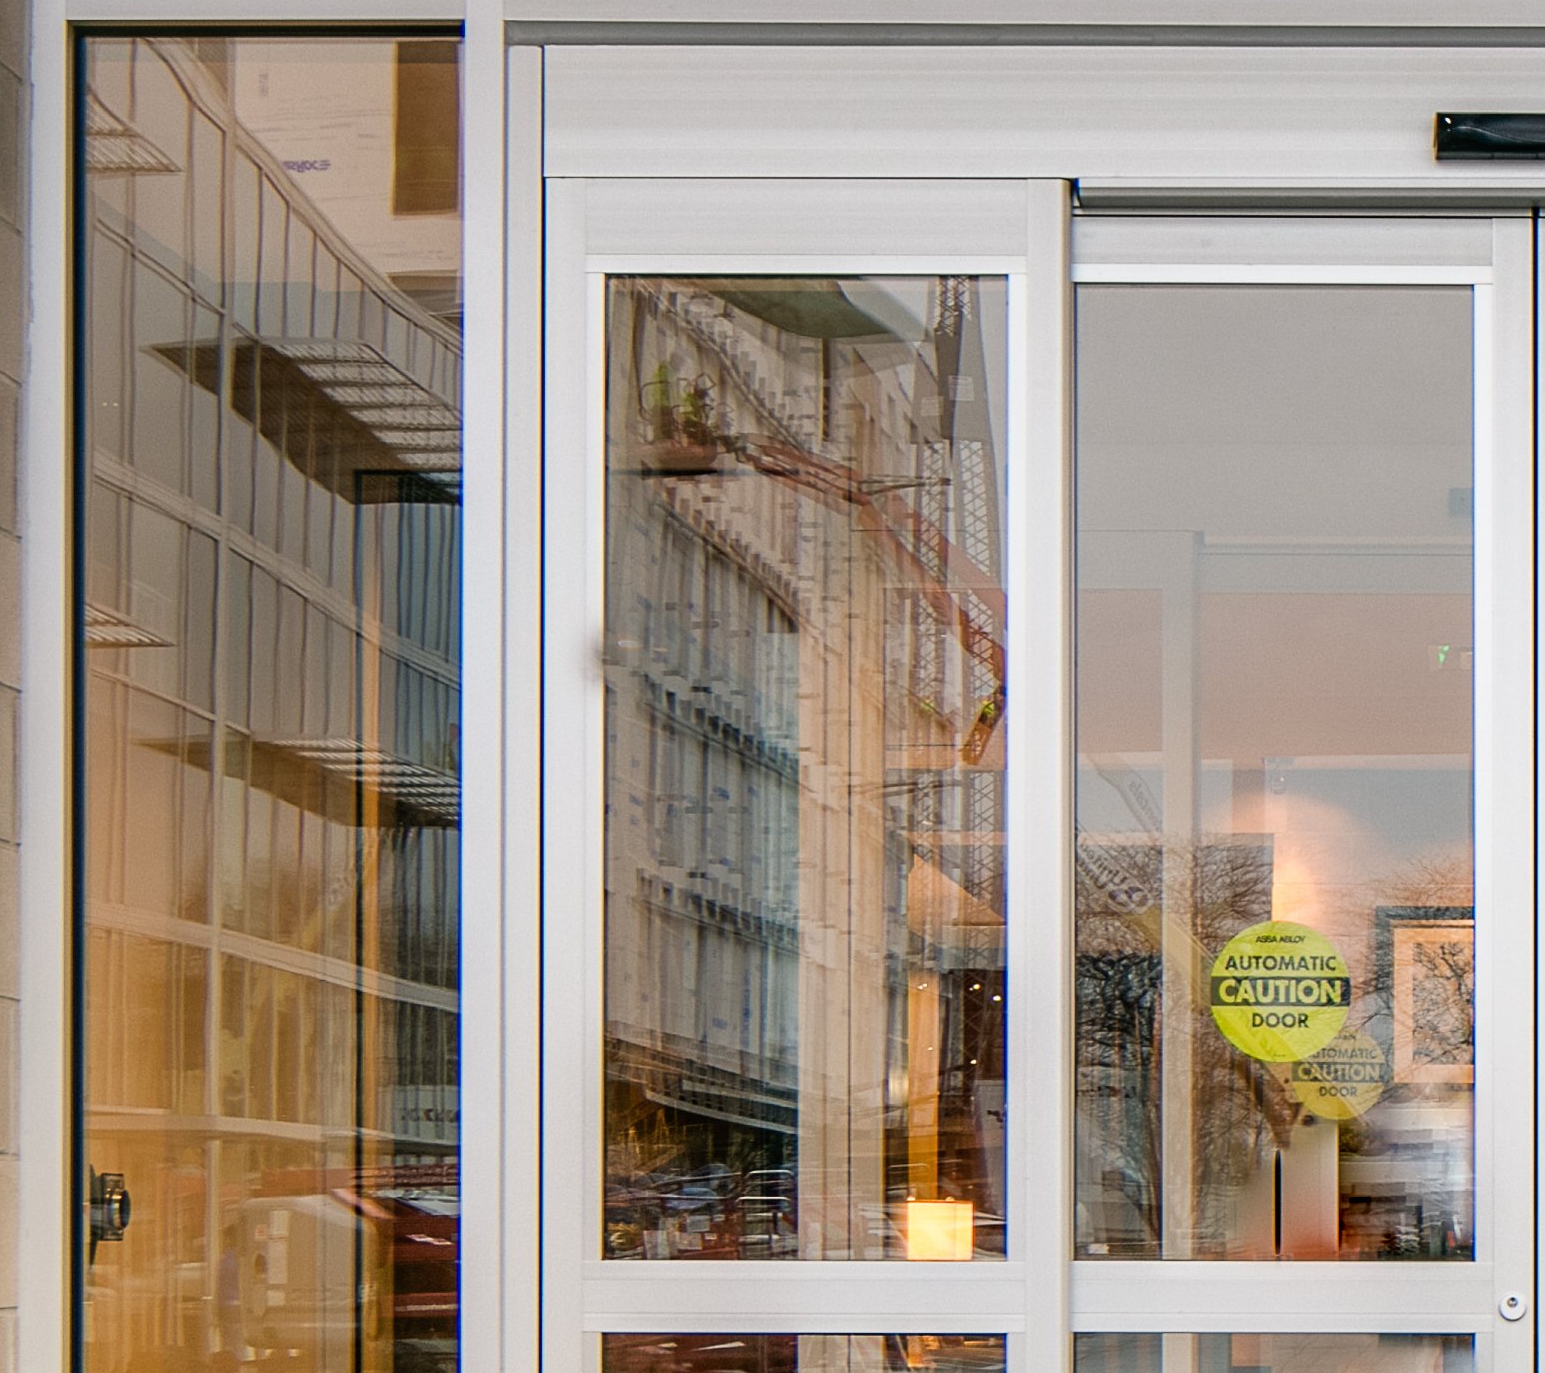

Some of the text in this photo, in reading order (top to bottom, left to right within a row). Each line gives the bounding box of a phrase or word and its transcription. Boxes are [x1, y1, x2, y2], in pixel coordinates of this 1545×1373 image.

[1255, 935, 1306, 944] ASSA ABLOY
[1225, 955, 1337, 971] AUTOMATIC
[1219, 979, 1342, 1004] CAUTION
[1252, 1013, 1309, 1028] DOOR
[1308, 1047, 1377, 1060] UTOMATIC
[1298, 1064, 1380, 1081] CAUTION
[1319, 1086, 1357, 1097] DOOR
